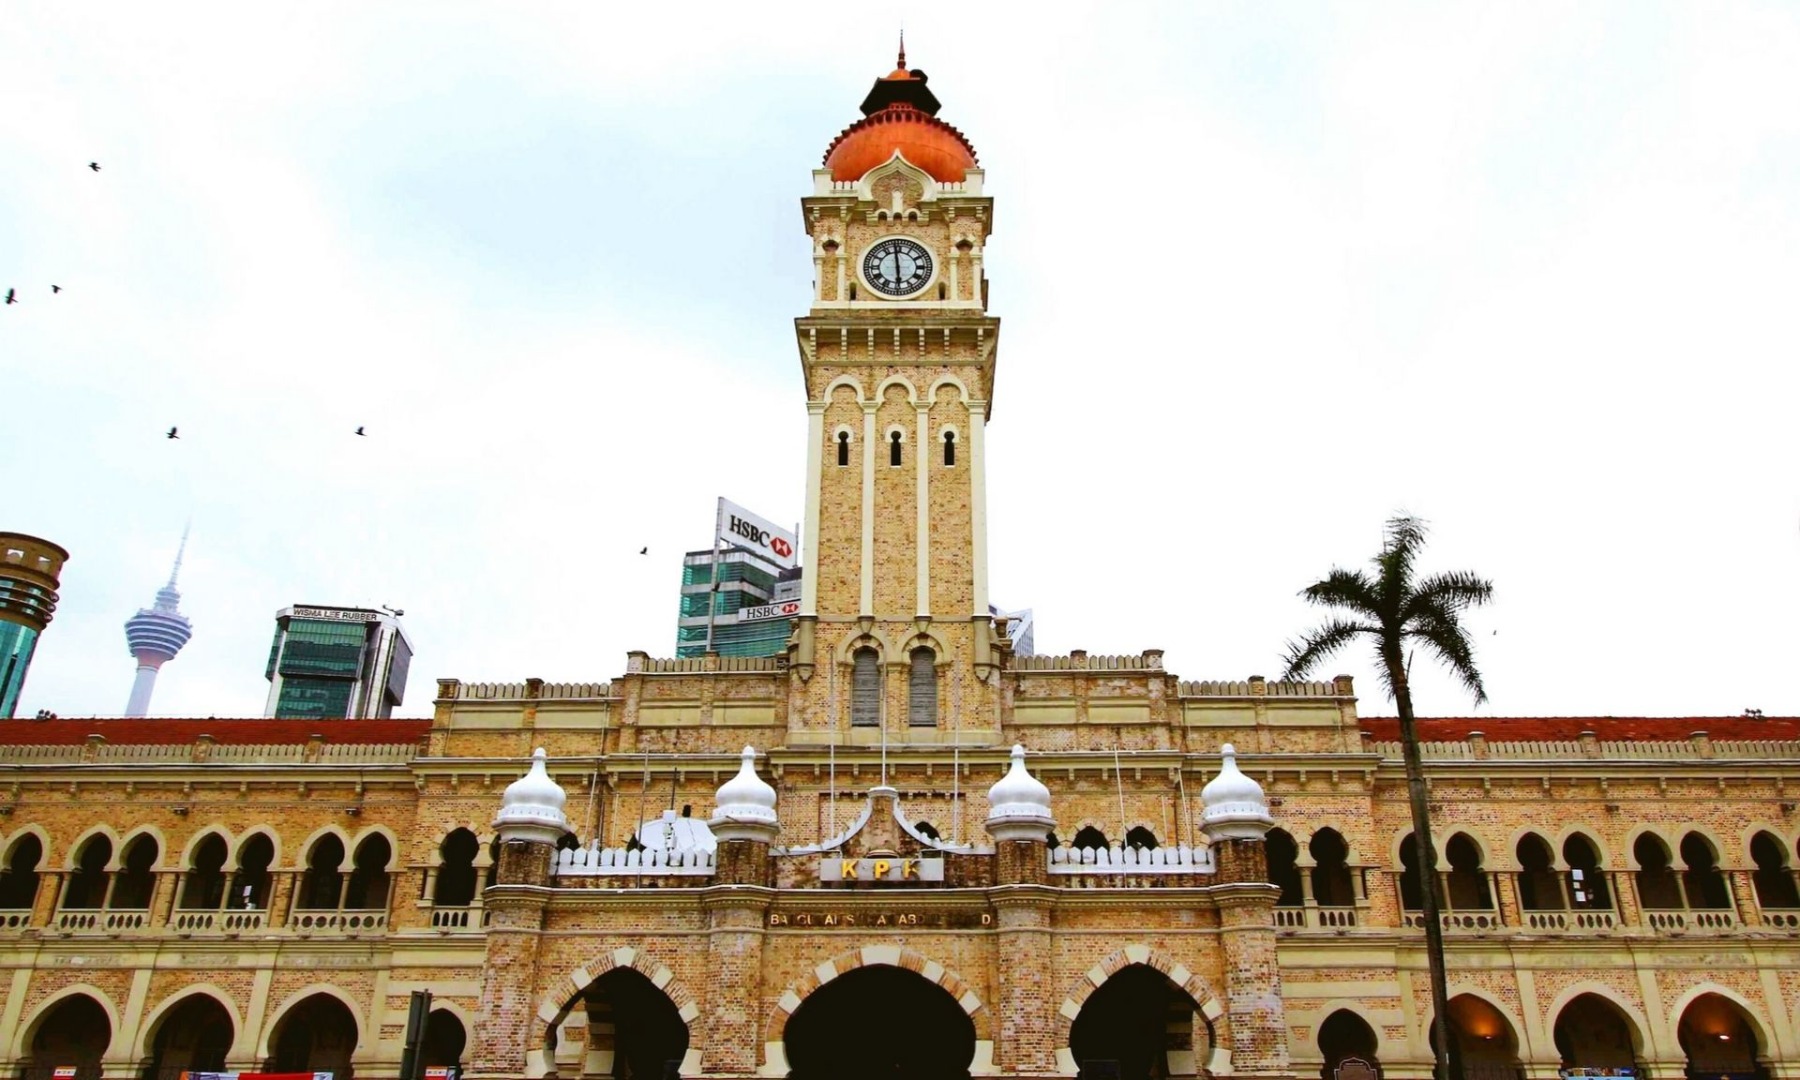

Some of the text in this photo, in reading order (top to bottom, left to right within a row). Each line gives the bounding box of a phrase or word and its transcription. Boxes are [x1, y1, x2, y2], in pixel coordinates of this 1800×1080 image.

[729, 515, 771, 548] HSBC
[293, 608, 322, 617] WISMA
[342, 612, 377, 621] RUBBER
[746, 605, 780, 619] HSBC
